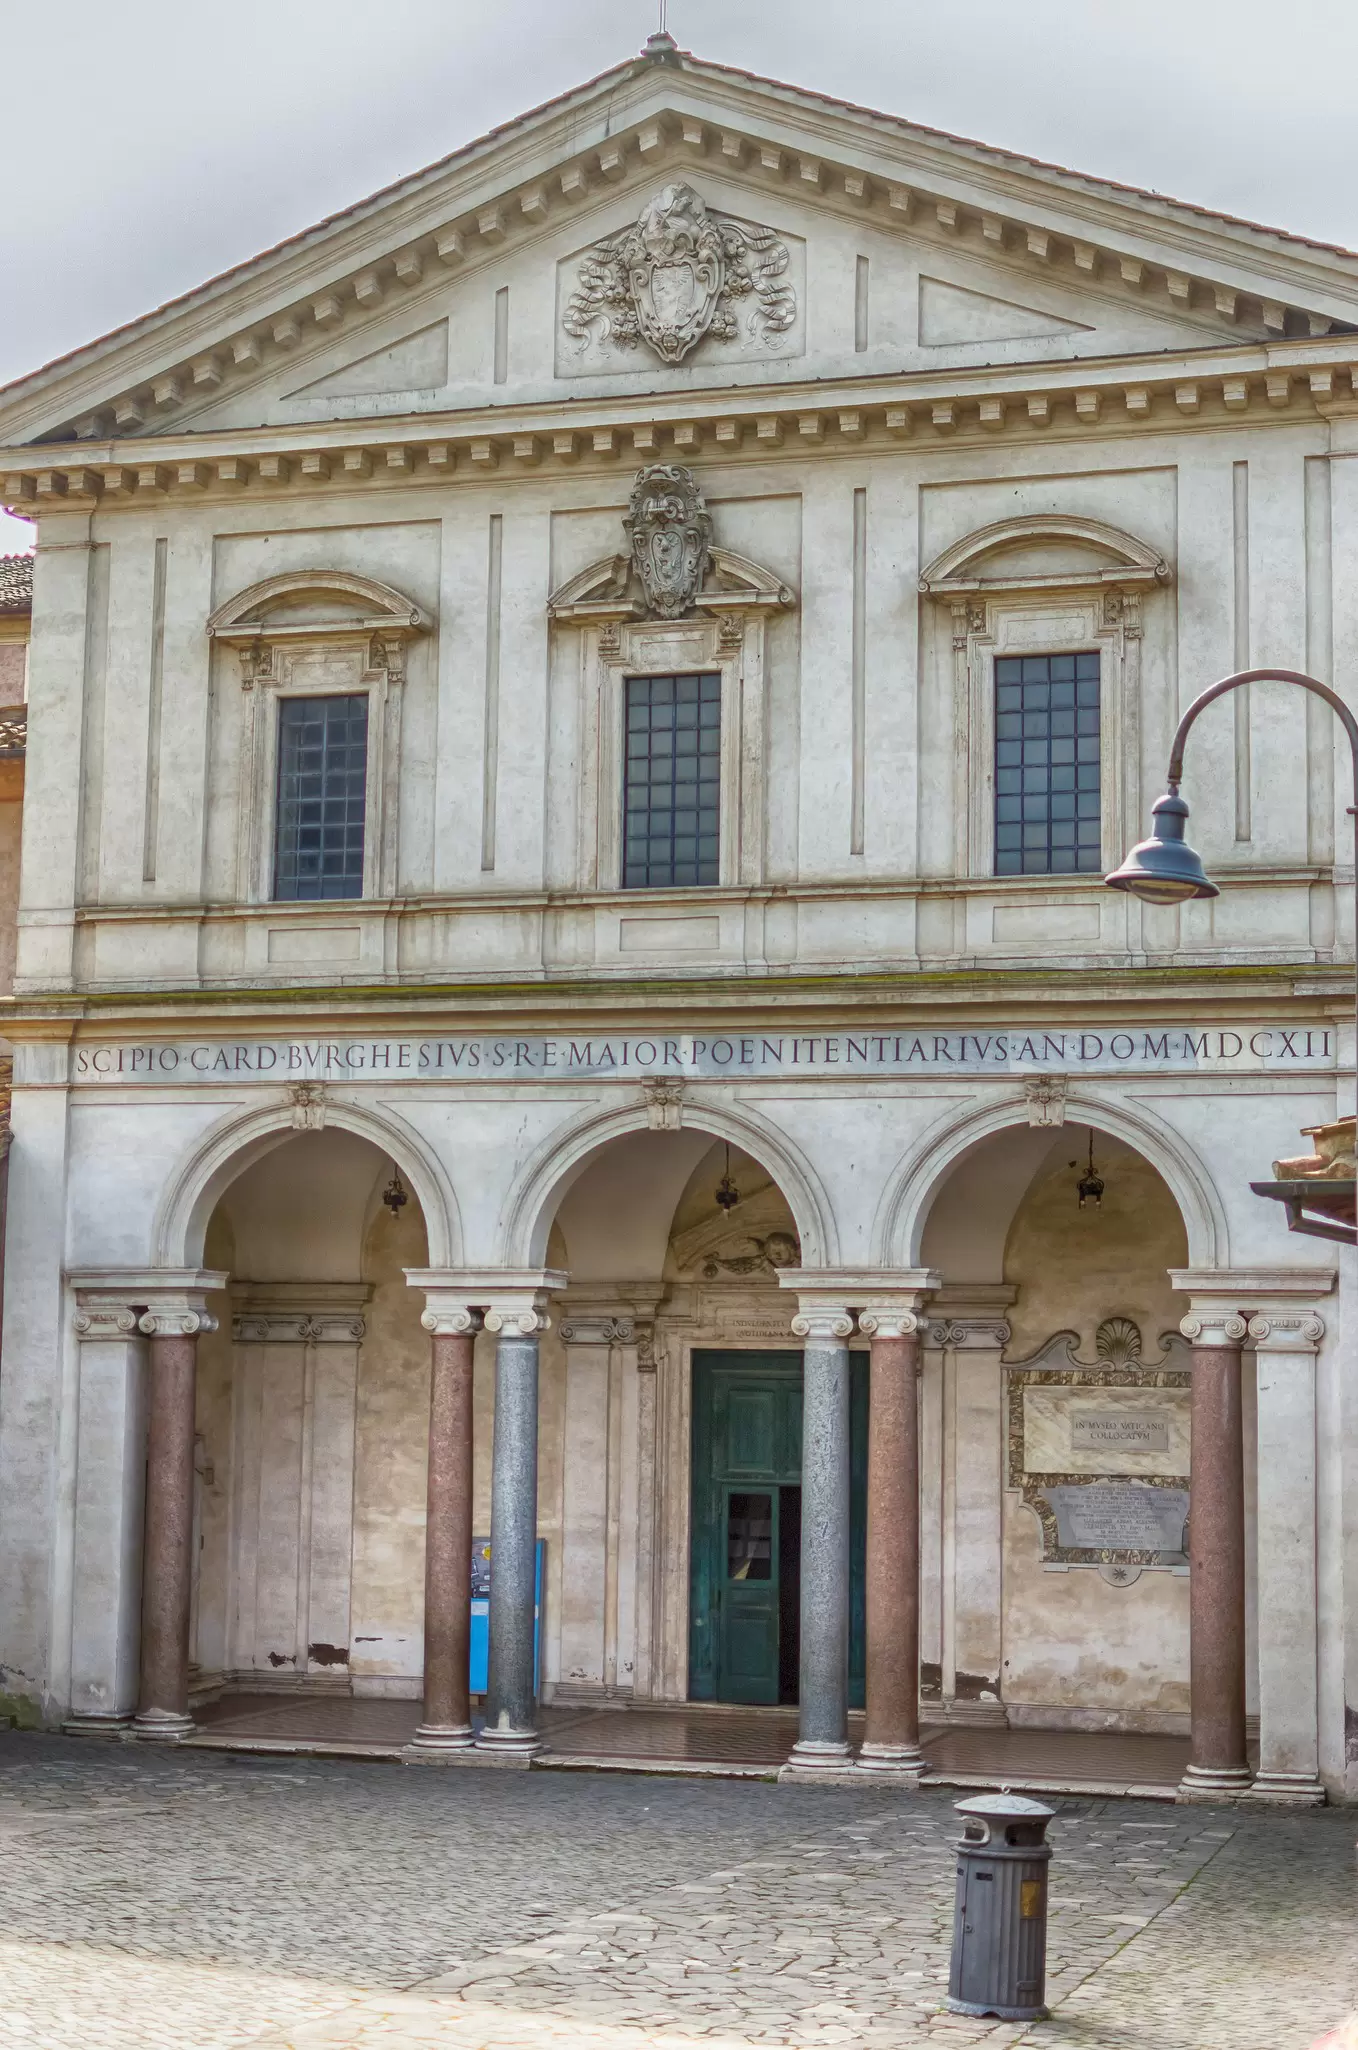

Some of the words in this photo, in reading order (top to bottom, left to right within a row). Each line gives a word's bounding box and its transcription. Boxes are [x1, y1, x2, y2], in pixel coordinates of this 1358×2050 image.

[77, 1046, 180, 1072] SCIPIO
[190, 1045, 277, 1071] CARD
[287, 1043, 481, 1069] BVRGHESIVS
[567, 1040, 683, 1066] MAIOR
[690, 1036, 1009, 1065] POENITENTIARIVS
[1182, 1031, 1332, 1059] MDCXII
[1075, 1421, 1085, 1429] IN
[1088, 1421, 1117, 1430] MVSEO
[1120, 1421, 1165, 1431] VATICANO
[1090, 1432, 1150, 1441] COLLOCATVM
